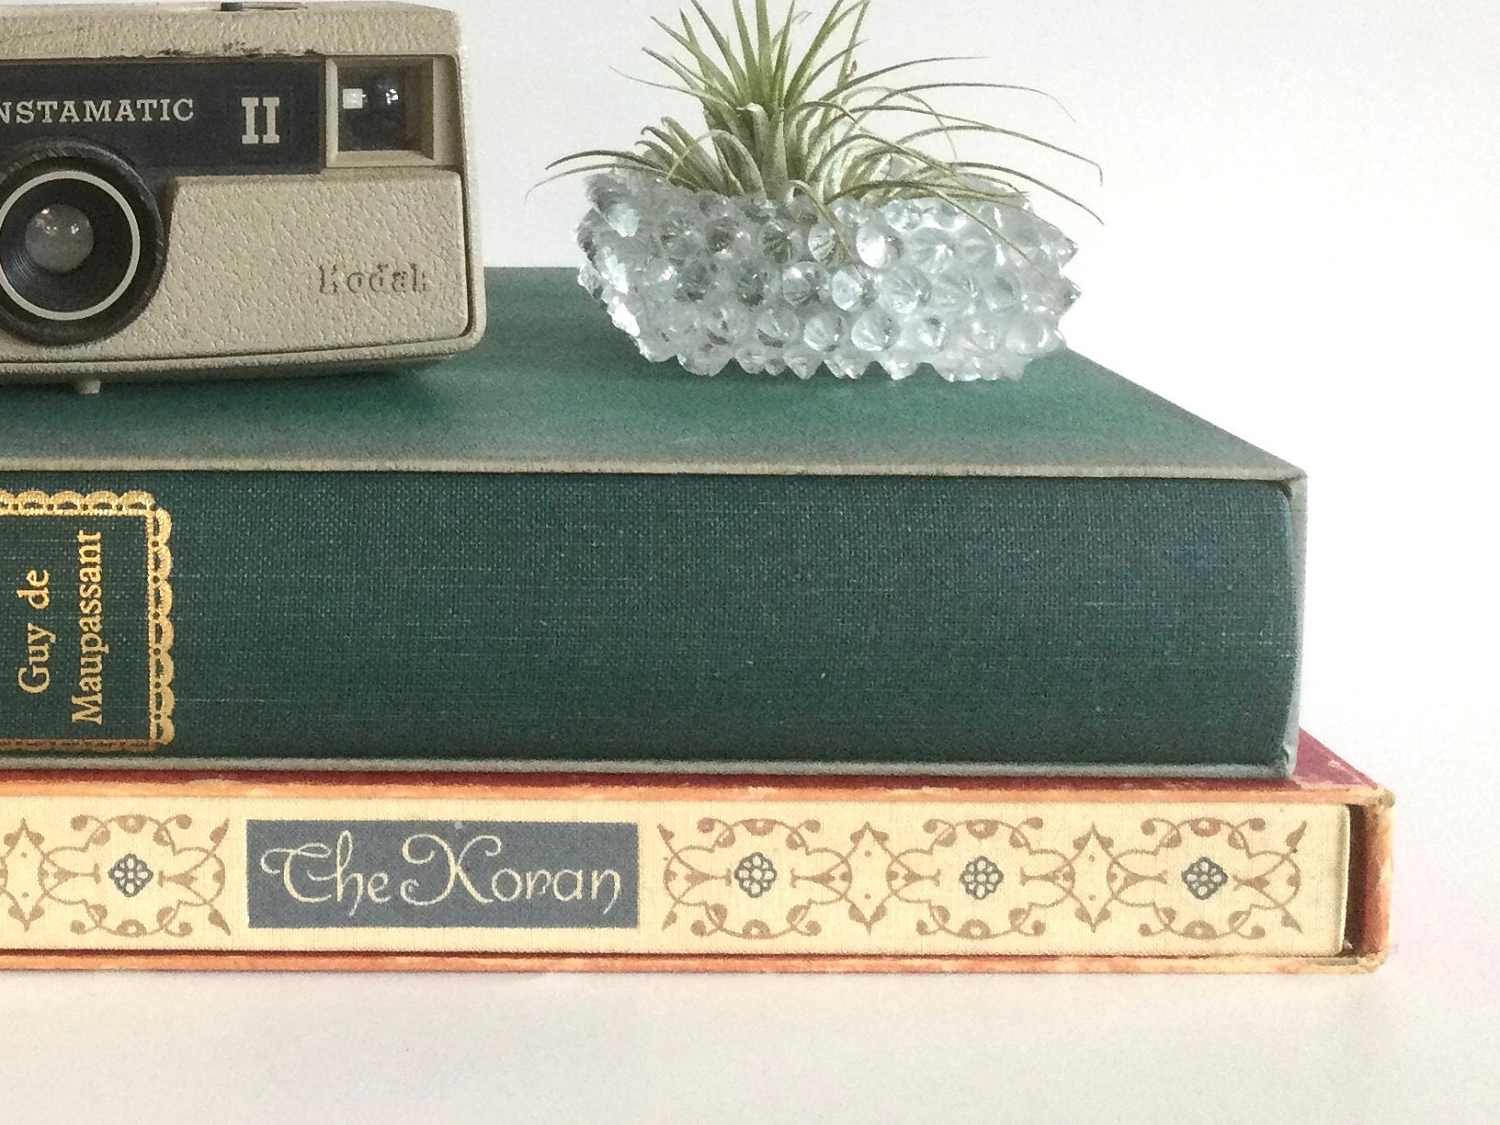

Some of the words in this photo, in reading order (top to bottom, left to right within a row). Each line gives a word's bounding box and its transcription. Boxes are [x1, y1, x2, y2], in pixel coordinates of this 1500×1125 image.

[241, 96, 281, 145] II
[318, 263, 431, 294] Kodak
[17, 569, 50, 610] de
[72, 530, 109, 725] Maupassant
[17, 623, 56, 694] Guy
[260, 829, 392, 917] The
[400, 833, 621, 915] Koran
